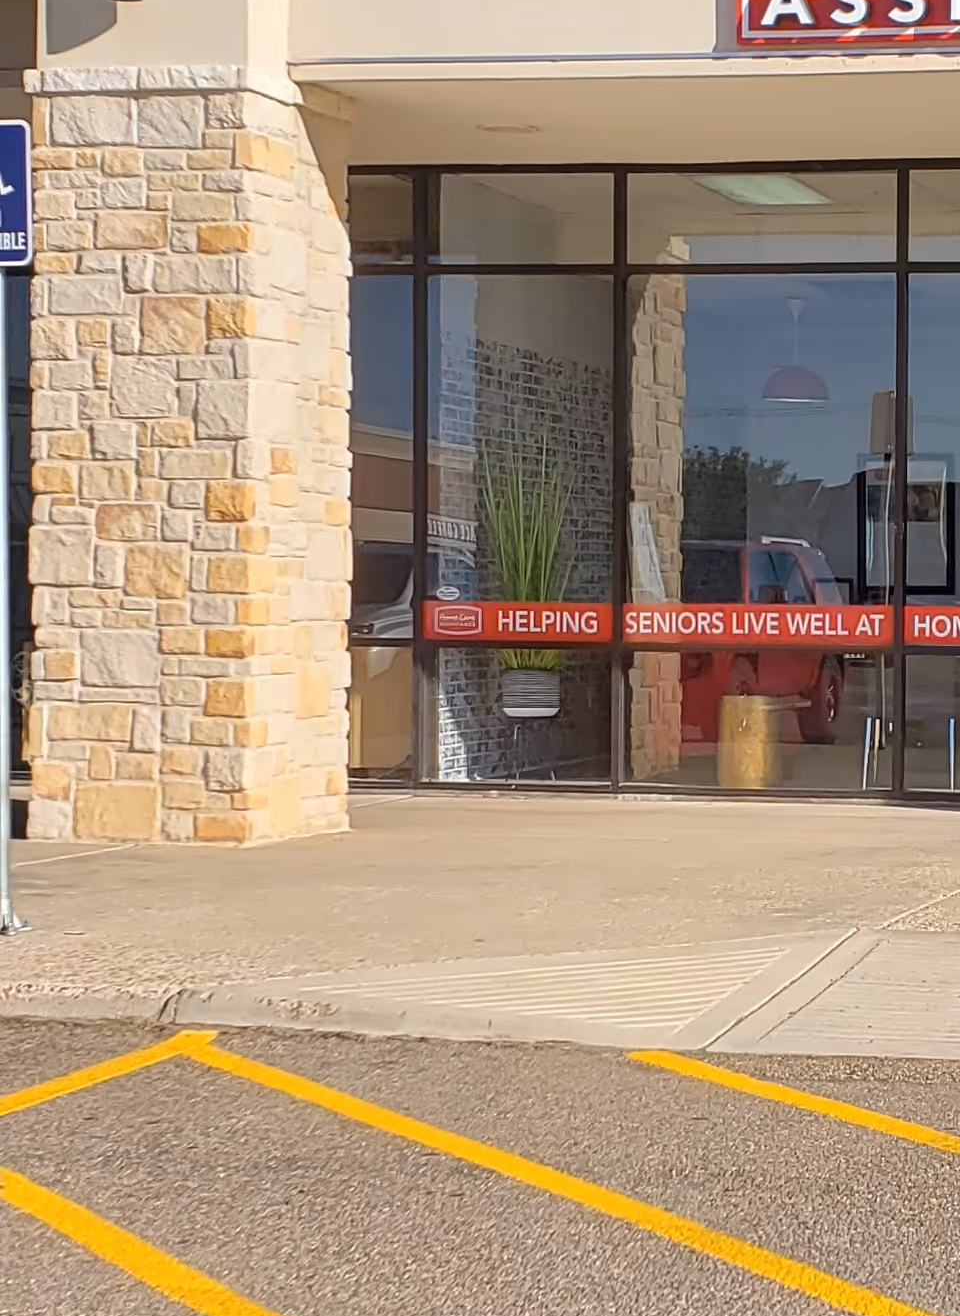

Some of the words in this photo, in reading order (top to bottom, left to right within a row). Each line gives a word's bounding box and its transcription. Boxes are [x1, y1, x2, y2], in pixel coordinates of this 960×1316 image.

[497, 610, 599, 633] HELPING
[625, 612, 724, 634] SENIORS
[732, 612, 780, 635] LIVE
[787, 613, 849, 636] WELL
[855, 614, 885, 636] AT
